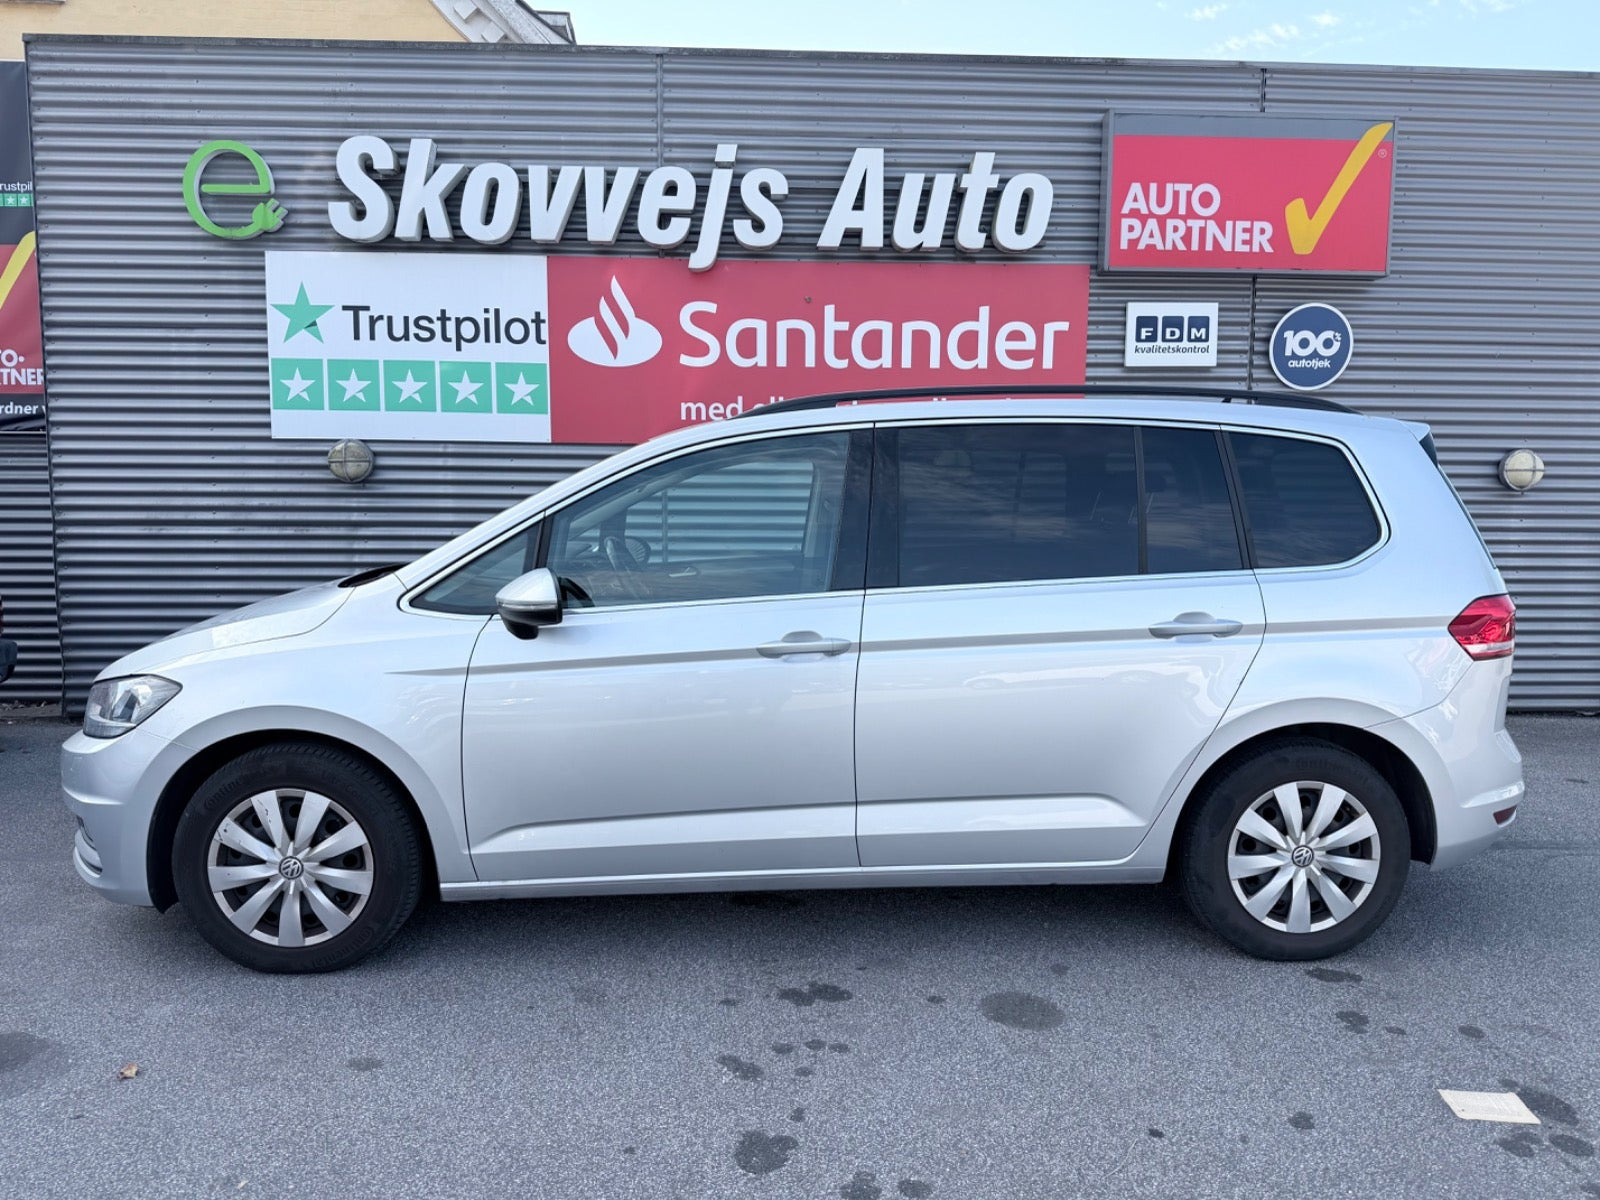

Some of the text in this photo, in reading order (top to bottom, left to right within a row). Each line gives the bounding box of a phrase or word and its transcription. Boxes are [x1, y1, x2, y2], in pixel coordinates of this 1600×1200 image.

[0, 181, 33, 193] rustpil
[1120, 182, 1221, 217] AUTO
[327, 135, 789, 272] Skovvejs
[816, 147, 1054, 252] Auto
[1119, 218, 1274, 253] PARTNER
[341, 305, 546, 352] Trustpilot
[678, 301, 1070, 370] Santander
[1134, 344, 1210, 355] kvalitetskontrol
[1287, 358, 1331, 370] autotjek
[0, 401, 38, 415] rdner
[680, 396, 743, 421] med
